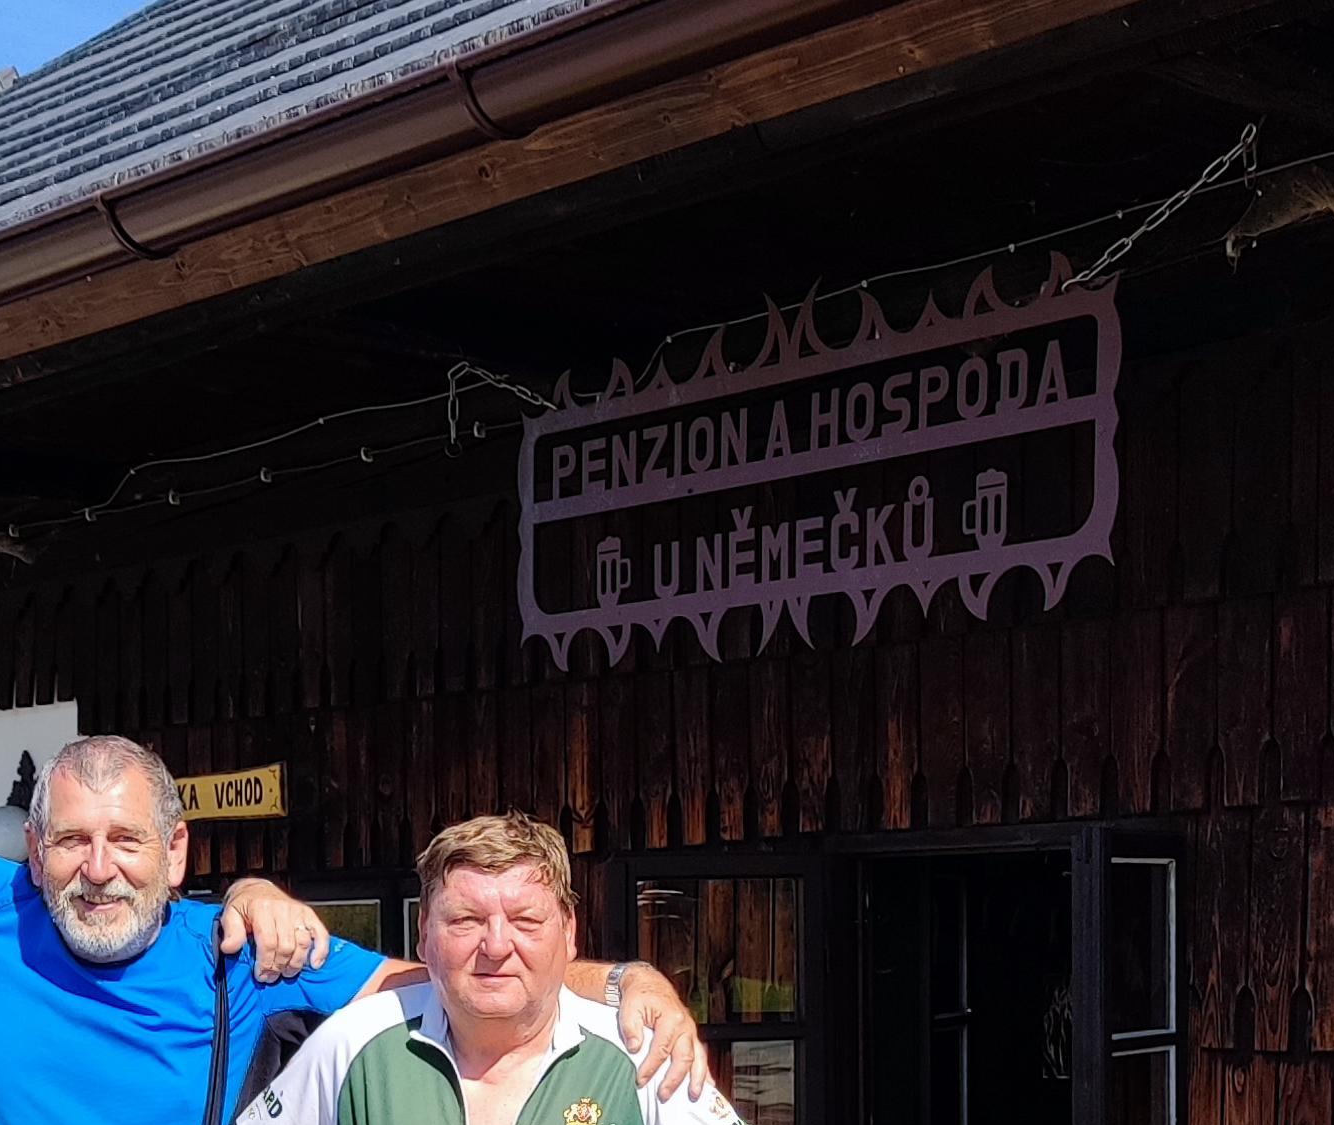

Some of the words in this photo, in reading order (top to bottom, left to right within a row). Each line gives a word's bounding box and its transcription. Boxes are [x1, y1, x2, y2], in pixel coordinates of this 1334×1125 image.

[551, 406, 749, 499] PENZION
[767, 399, 795, 459] A
[808, 339, 1068, 450] HOSPODA
[653, 540, 680, 600] U
[695, 475, 935, 588] NĚMEČKŮ
[177, 783, 200, 811] KA
[214, 776, 263, 810] VCHOD
